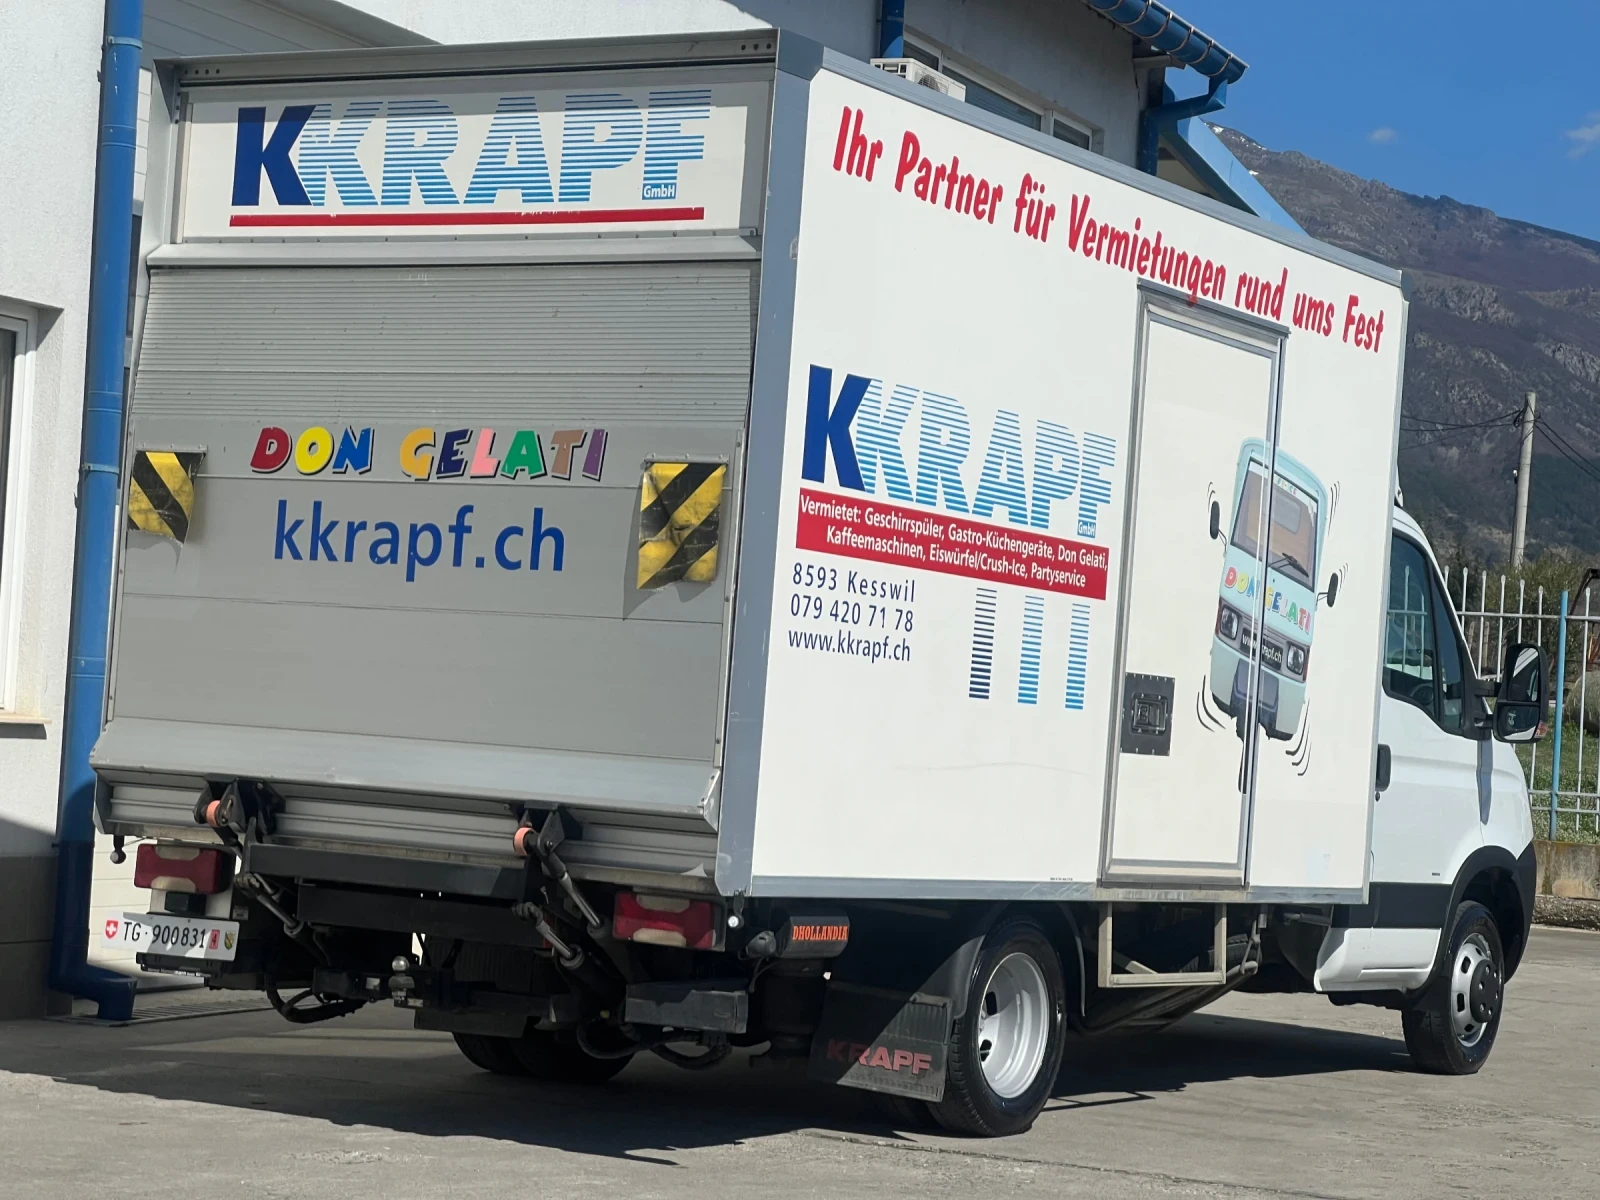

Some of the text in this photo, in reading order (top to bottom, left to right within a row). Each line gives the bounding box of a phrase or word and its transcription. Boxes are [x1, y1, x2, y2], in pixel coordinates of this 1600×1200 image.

[231, 89, 712, 207] KKRAPF
[643, 184, 676, 198] GmbH
[833, 106, 1385, 353] Ihr Partner für Vermietungen rund ums Fest
[250, 425, 608, 482] DON GELATI
[801, 363, 1117, 529] KKRAPF
[274, 499, 565, 582] kkrapf.ch
[800, 494, 1108, 571] Vermietet: Geschirrspüler, Gastro-Küchengeräte, Don Gelati,
[1078, 521, 1096, 537] GmbH
[826, 525, 1086, 587] Kaffeemaschinen, Eiswürfel/Crush-Ice, Partyservice
[792, 562, 915, 602] 8593 Kesswil
[790, 593, 913, 632] 079 420 71 78
[788, 629, 911, 664] www.kkrapf.ch
[792, 925, 849, 941] DHOLLANDIA
[827, 1039, 932, 1075] KRAPF
